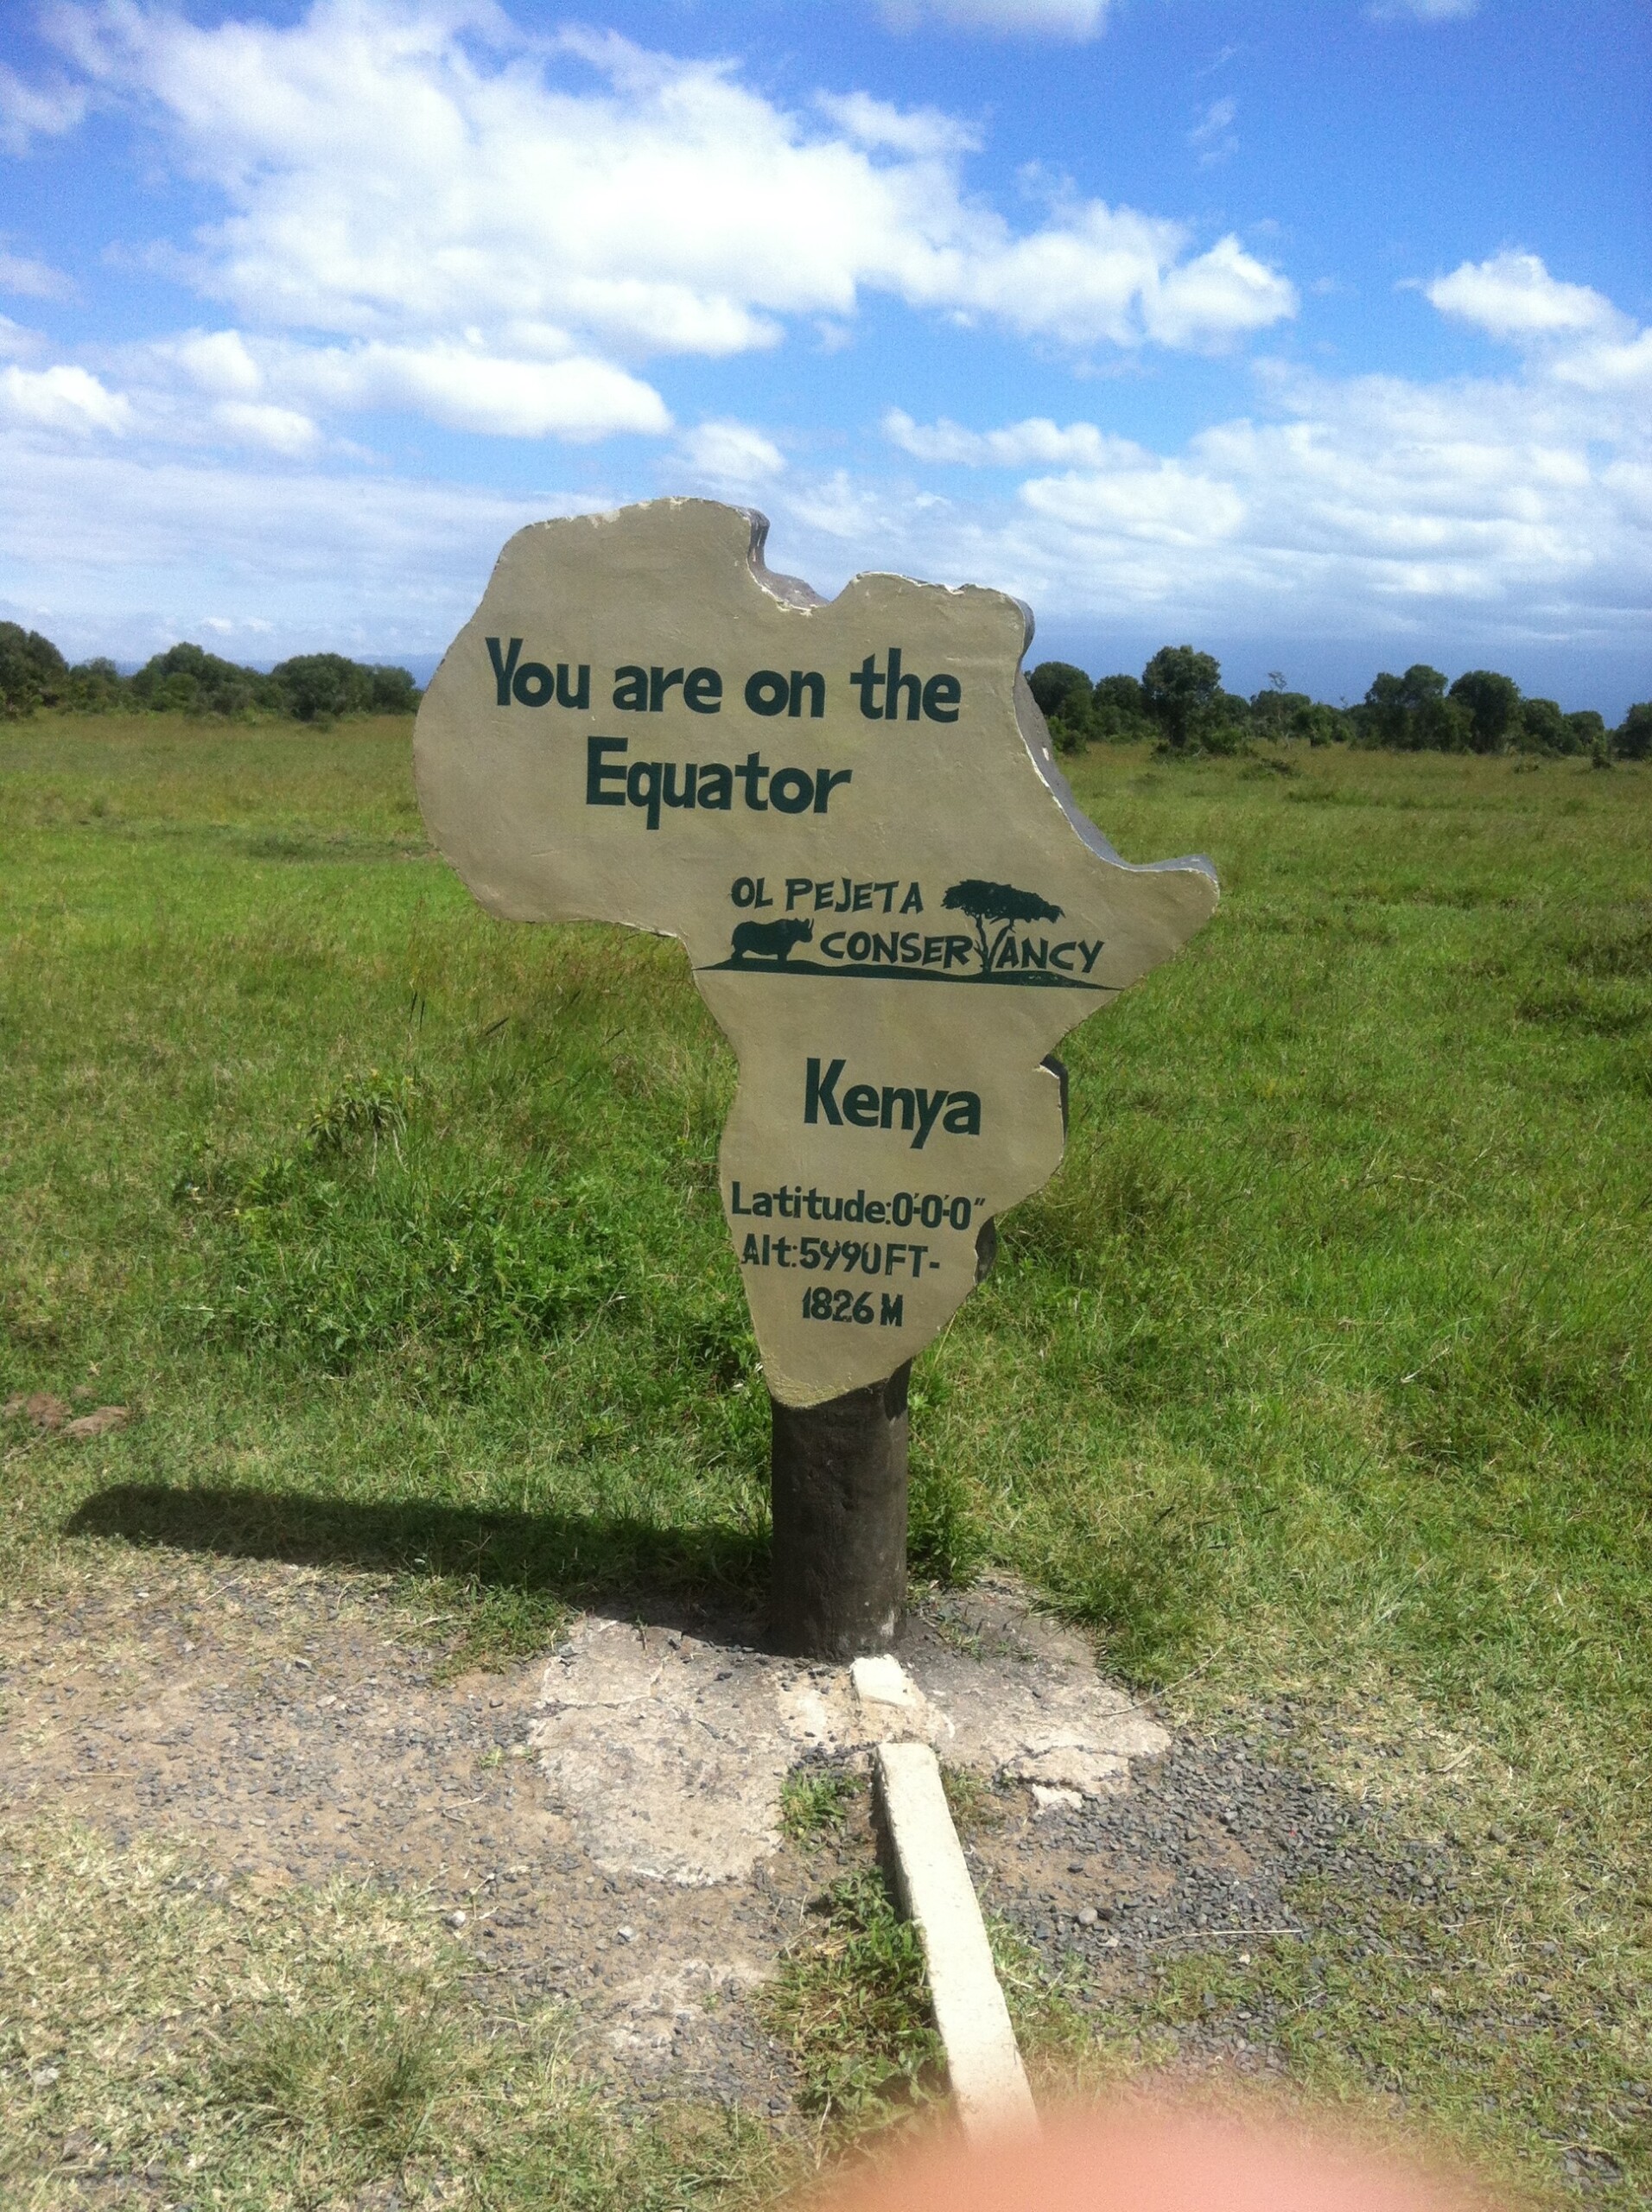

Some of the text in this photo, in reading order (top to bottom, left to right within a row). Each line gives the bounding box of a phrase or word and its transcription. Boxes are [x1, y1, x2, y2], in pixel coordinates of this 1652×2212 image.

[485, 637, 962, 723] You are on the
[586, 735, 854, 830] Equator
[730, 876, 924, 915] OL PEJETA
[819, 929, 1106, 974] CONSERVANCY
[804, 1057, 982, 1150] Kenya
[802, 1286, 904, 1327] 1826 M
